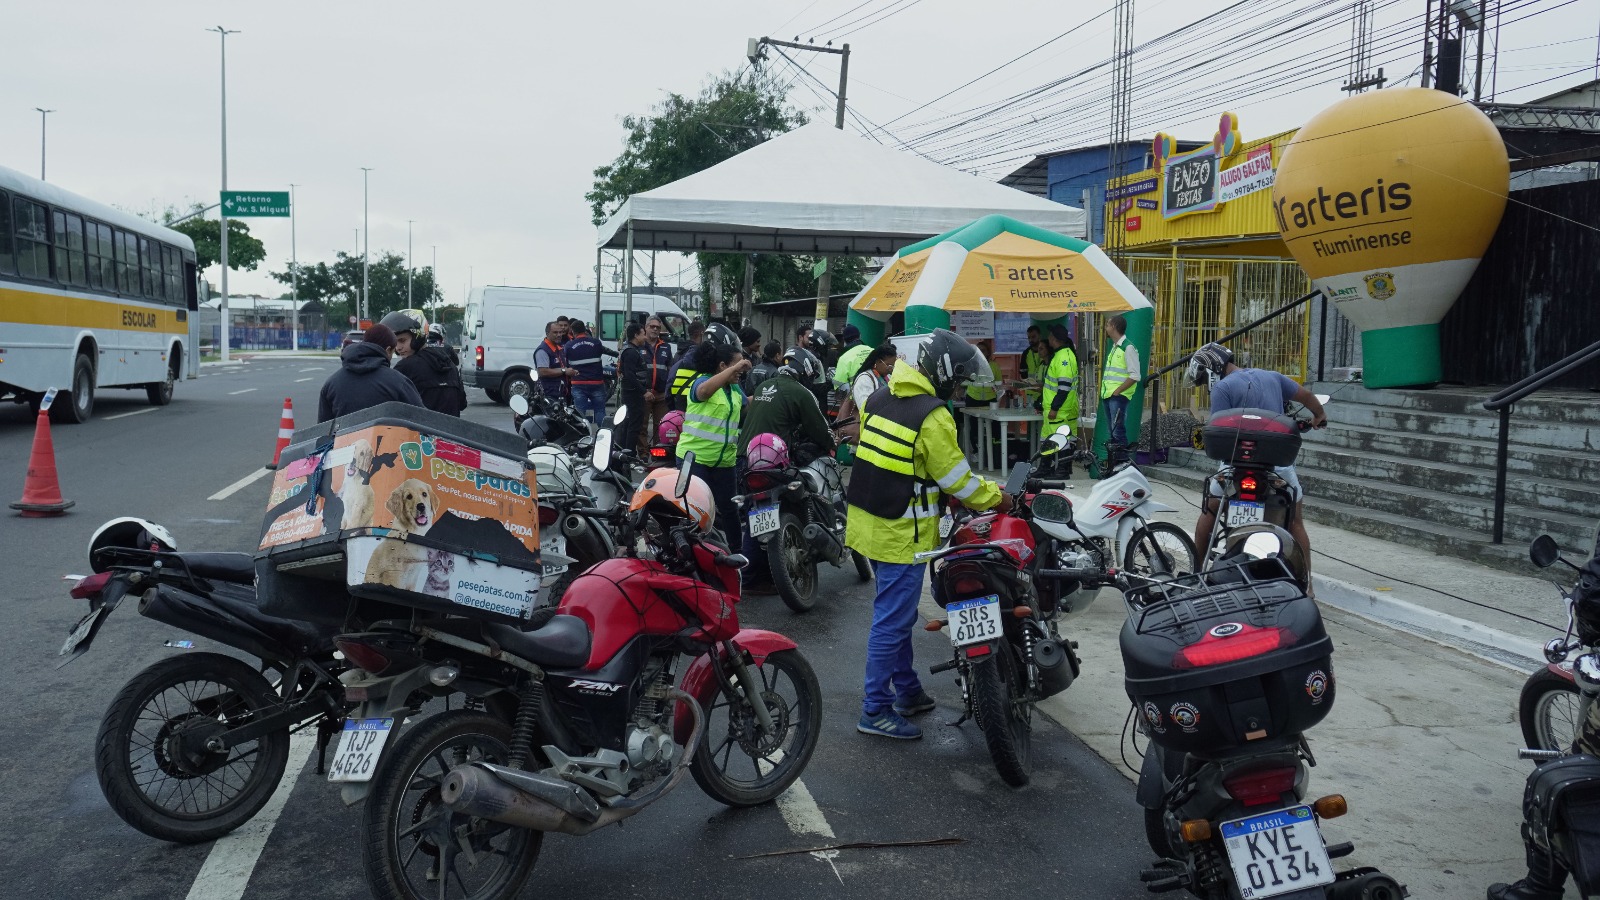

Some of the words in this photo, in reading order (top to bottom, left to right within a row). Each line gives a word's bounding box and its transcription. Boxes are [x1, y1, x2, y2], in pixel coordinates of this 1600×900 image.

[1173, 160, 1210, 192] ENZO
[1220, 167, 1242, 188] ALUGO
[235, 195, 271, 203] Retorno
[1176, 188, 1203, 207] FESTAS
[1290, 178, 1412, 229] arteris
[259, 206, 289, 215] Miguel
[1312, 230, 1412, 258] Fluminense
[1008, 264, 1074, 281] arteris
[1010, 289, 1078, 299] Fluminense
[122, 310, 157, 328] ESCOLAR
[436, 484, 450, 493] Seu
[462, 492, 482, 502] nossa
[755, 511, 773, 524] SRY
[500, 520, 533, 538] ÁPIDA
[457, 580, 533, 603] pesepatas.com.br
[464, 595, 531, 619] @redepesepaas
[962, 601, 983, 609] BRASIL
[958, 605, 989, 625] SRS
[956, 620, 996, 641] 6D13
[568, 680, 624, 692] FAN
[346, 730, 378, 752] RJP
[336, 752, 373, 775] 4G26
[1250, 818, 1285, 832] BRASIL
[1245, 825, 1303, 861] KYE
[1242, 887, 1255, 898] BR
